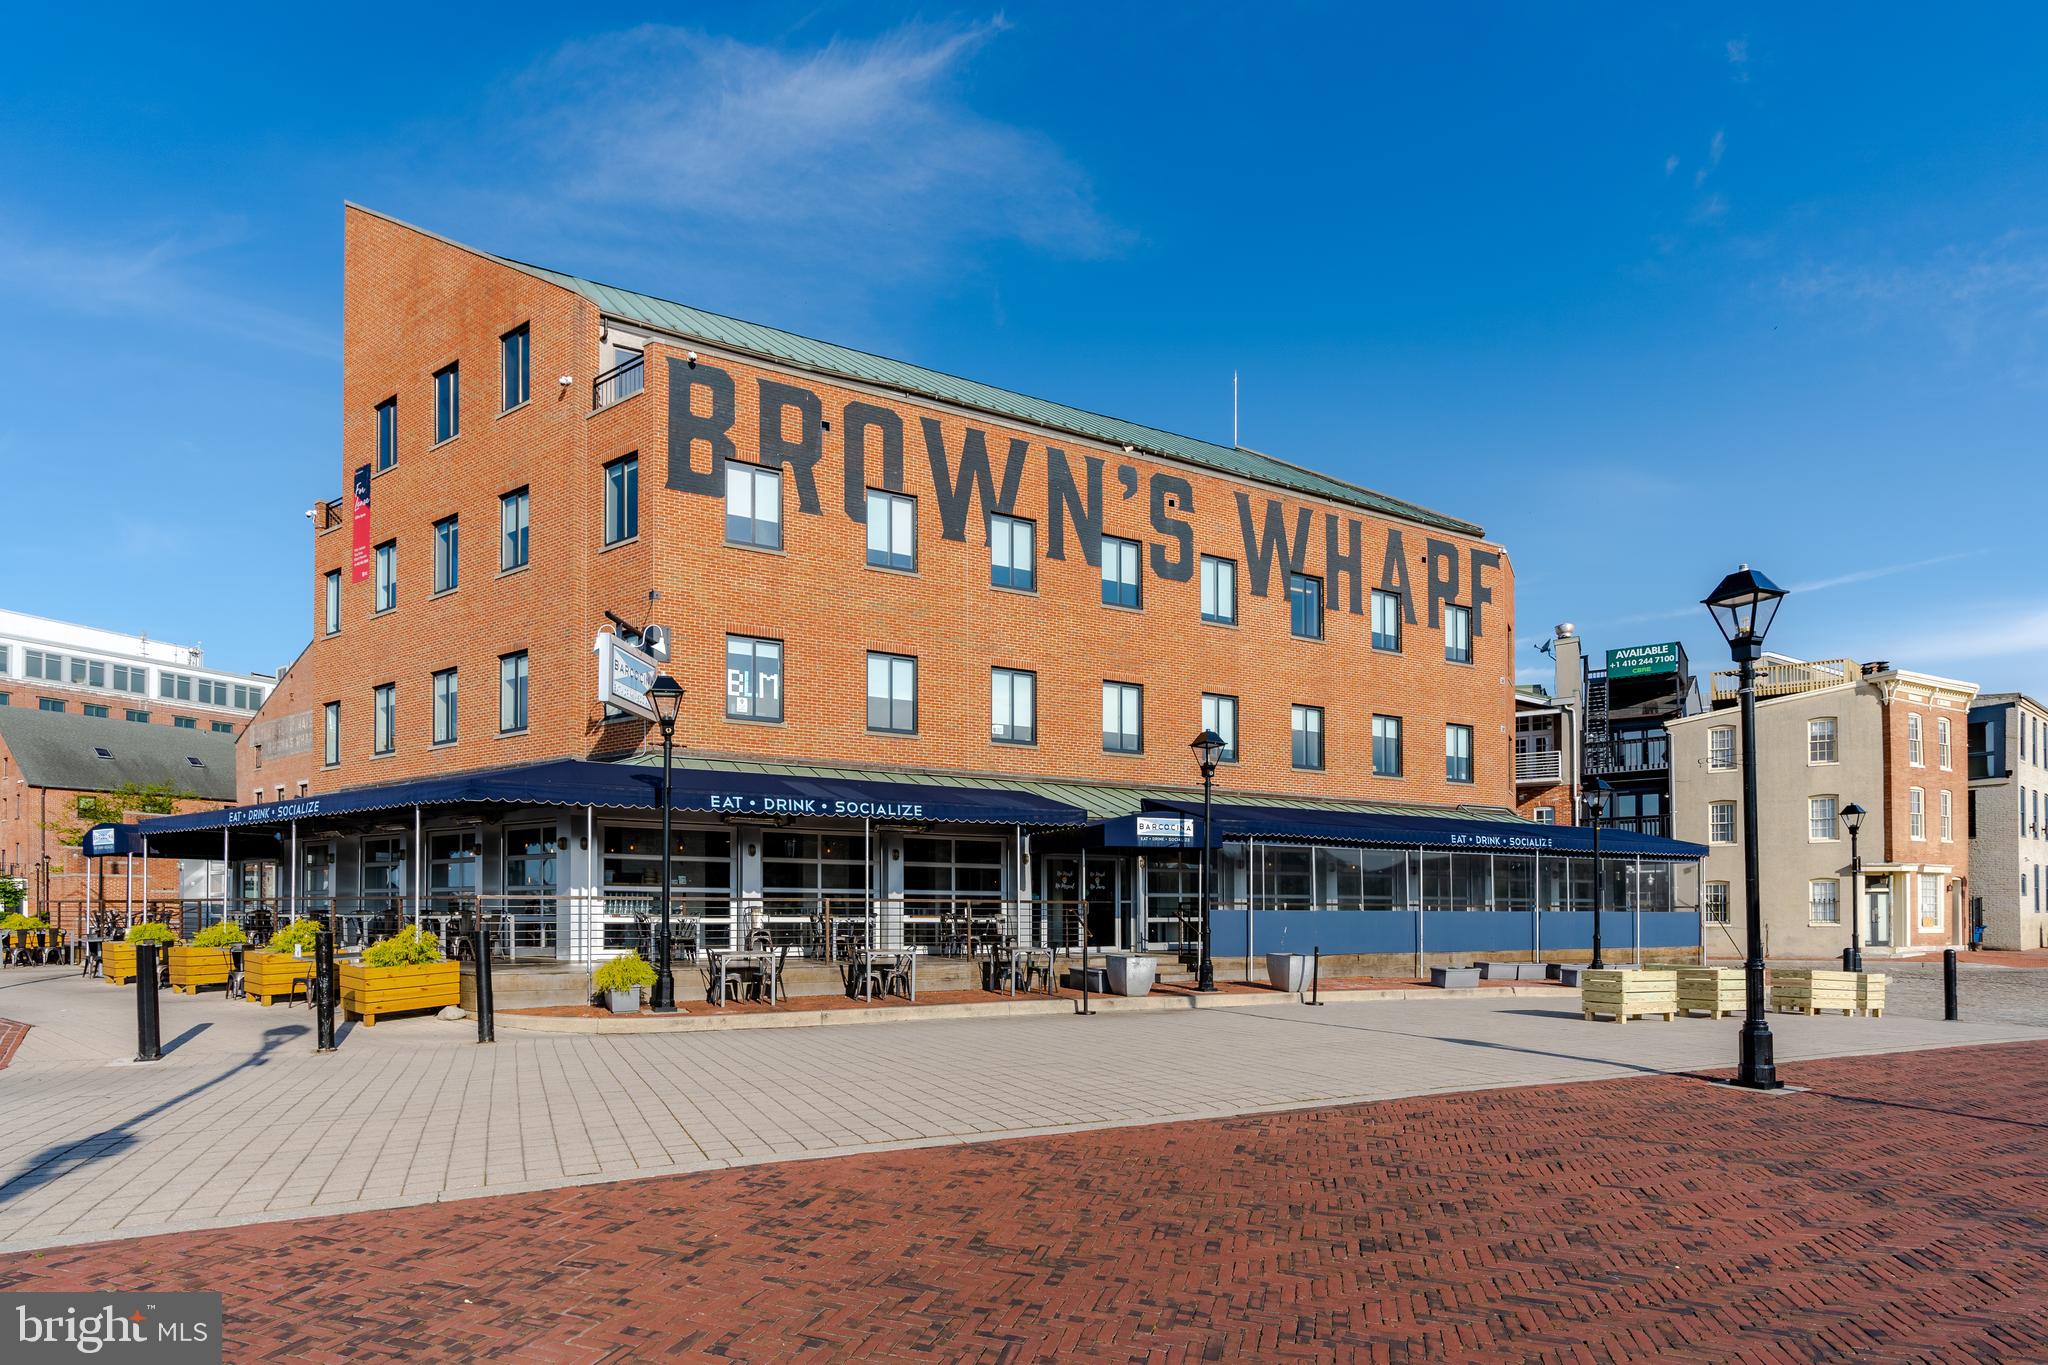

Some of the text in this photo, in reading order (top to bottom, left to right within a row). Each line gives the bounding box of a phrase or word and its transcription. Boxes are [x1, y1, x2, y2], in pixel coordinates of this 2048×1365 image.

[665, 356, 1500, 637] BROWN'S WHARF
[1616, 645, 1669, 659] AVAILABLE
[1622, 659, 1637, 667] 410
[1638, 657, 1653, 665] 244
[1654, 655, 1675, 663] 7100
[728, 669, 778, 699] BLM
[228, 801, 320, 822] EAT DRINK SOCIALIZE
[710, 796, 922, 816] EAT DRINK SOCIALIZE
[1139, 823, 1191, 831] BARCOCINA
[1451, 834, 1553, 847] EAT DRINK SOCIALIZE
